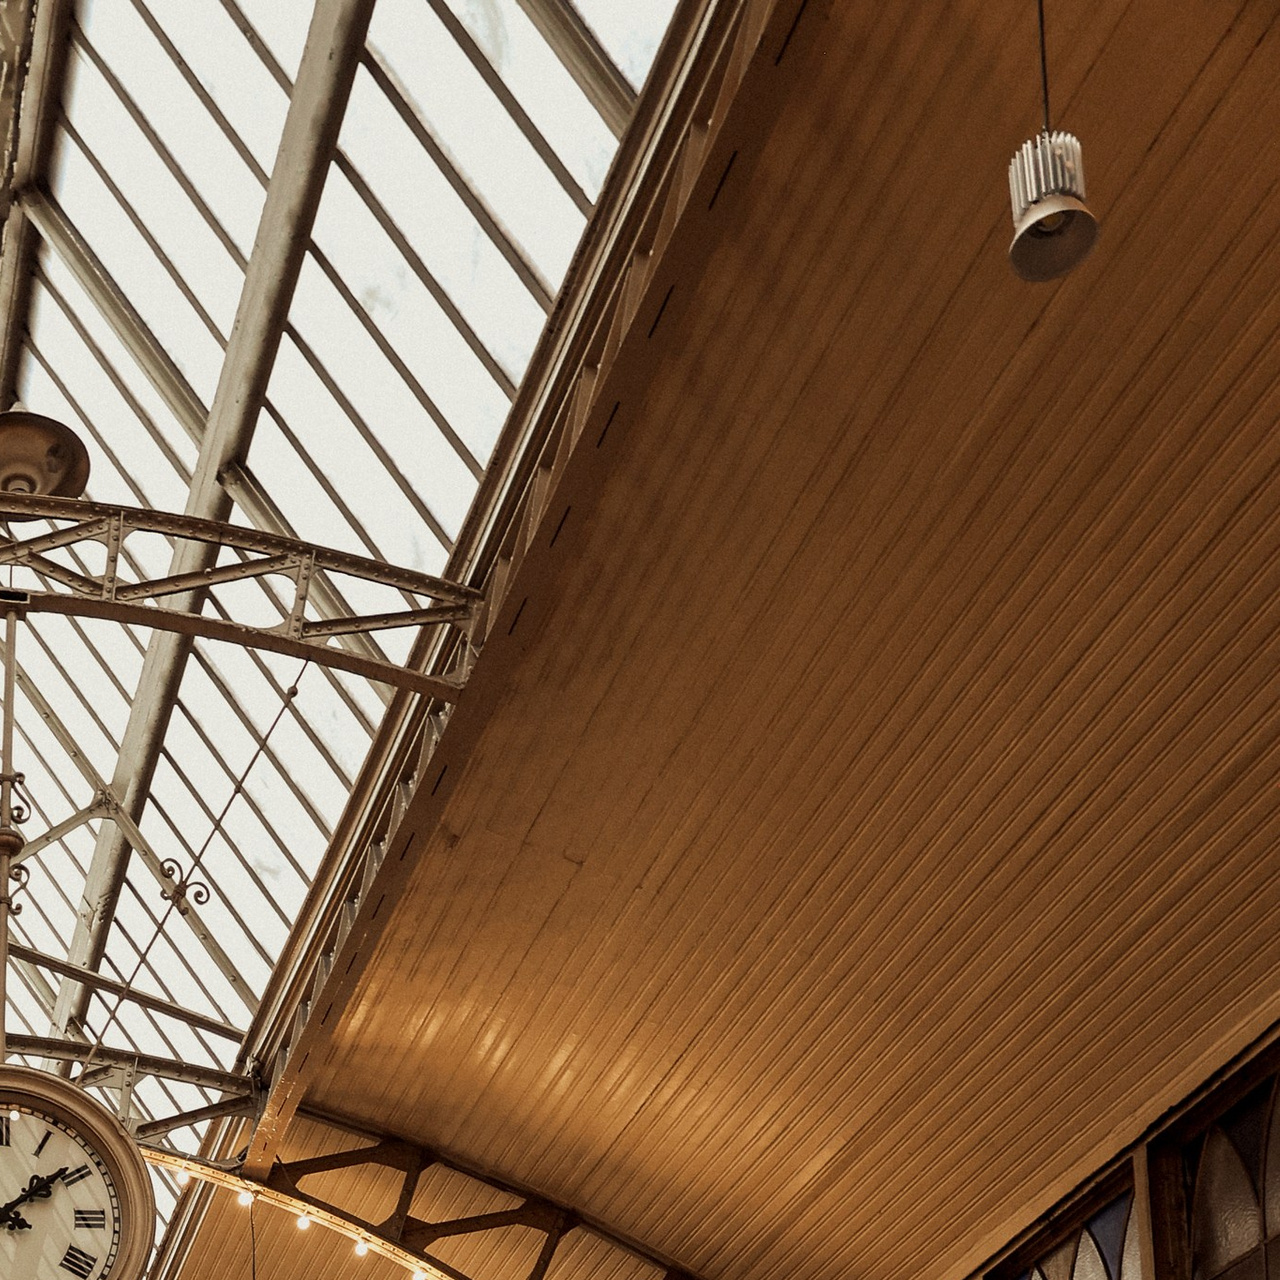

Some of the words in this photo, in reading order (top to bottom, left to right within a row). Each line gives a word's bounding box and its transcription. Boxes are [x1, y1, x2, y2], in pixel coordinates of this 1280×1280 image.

[33, 1130, 54, 1158] I
[61, 1164, 93, 1188] II
[73, 1208, 106, 1230] III
